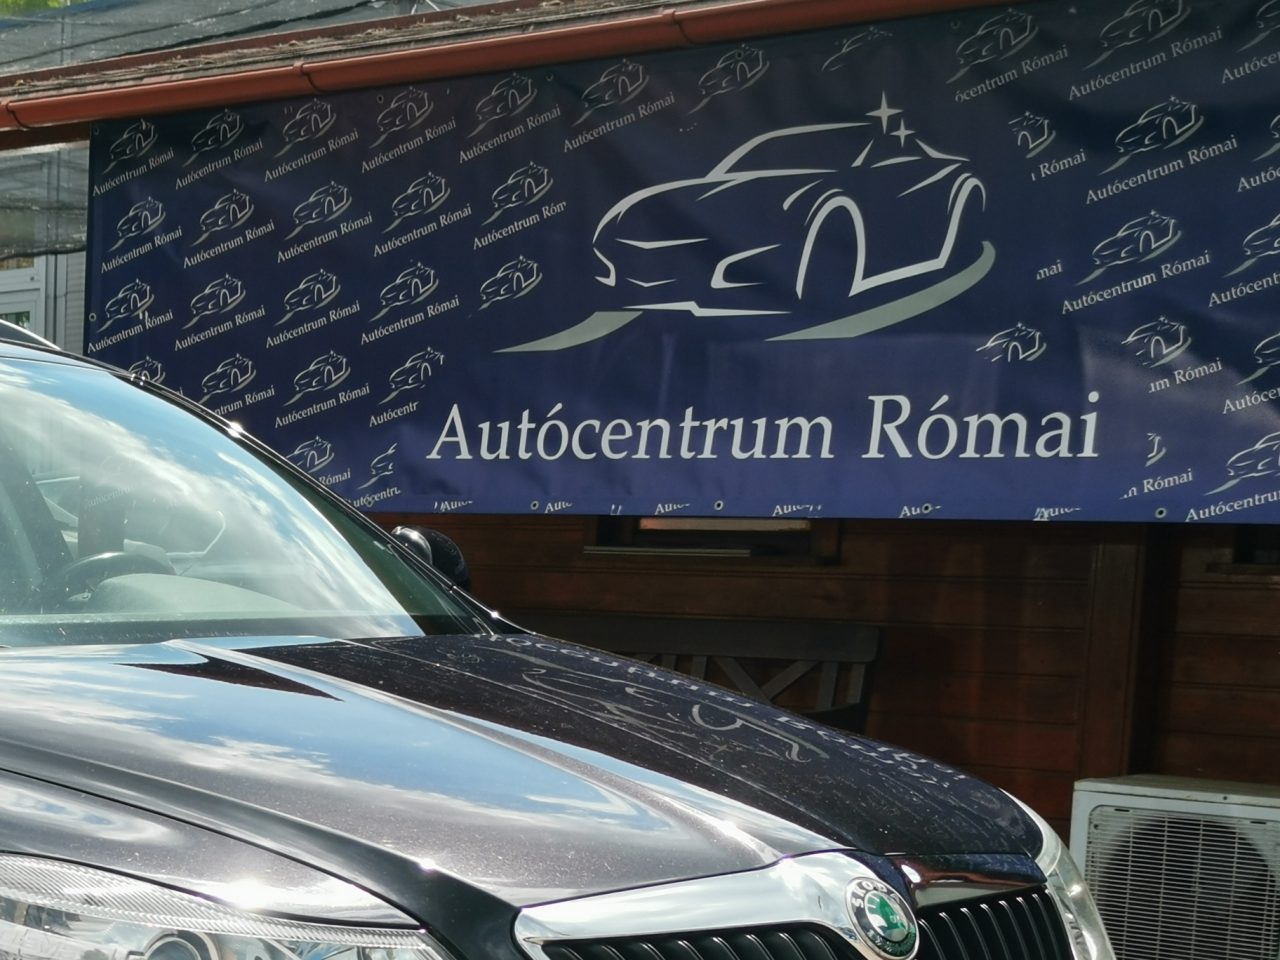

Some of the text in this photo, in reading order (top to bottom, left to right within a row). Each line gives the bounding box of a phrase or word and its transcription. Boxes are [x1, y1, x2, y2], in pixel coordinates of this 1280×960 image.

[1021, 44, 1068, 74] Római
[1070, 25, 1223, 100] Autócentrum Római
[361, 117, 456, 173] Autócentrum Római
[459, 104, 561, 163] Autócentrum Római
[563, 91, 675, 152] Autócentrum Római
[92, 149, 175, 197] Autócentrum Római
[175, 138, 263, 190] Autócentrum Római
[264, 128, 359, 182] Autócentrum Római
[1039, 149, 1087, 179] Római
[1086, 134, 1238, 204] Autócentrum Római
[101, 226, 183, 274] Autócentrum Római
[183, 220, 275, 269] Autócentrum Római
[277, 211, 373, 264] Autócentrum Római
[373, 203, 472, 257] Autócentrum Római
[473, 211, 541, 250] Autócentrum
[1061, 250, 1211, 315] Autócentrum Római
[87, 309, 173, 354] Autócentrum Római
[174, 305, 266, 352] Autócentrum Római
[266, 300, 360, 349] Autócentrum Római
[360, 295, 460, 346] Autócentrum Római
[244, 385, 276, 407] Római
[1174, 357, 1223, 386] Római
[274, 383, 370, 429] Autócentrum Római
[425, 390, 1100, 460] Autócentrum Római
[318, 467, 351, 486] Római
[1143, 468, 1193, 493] Római
